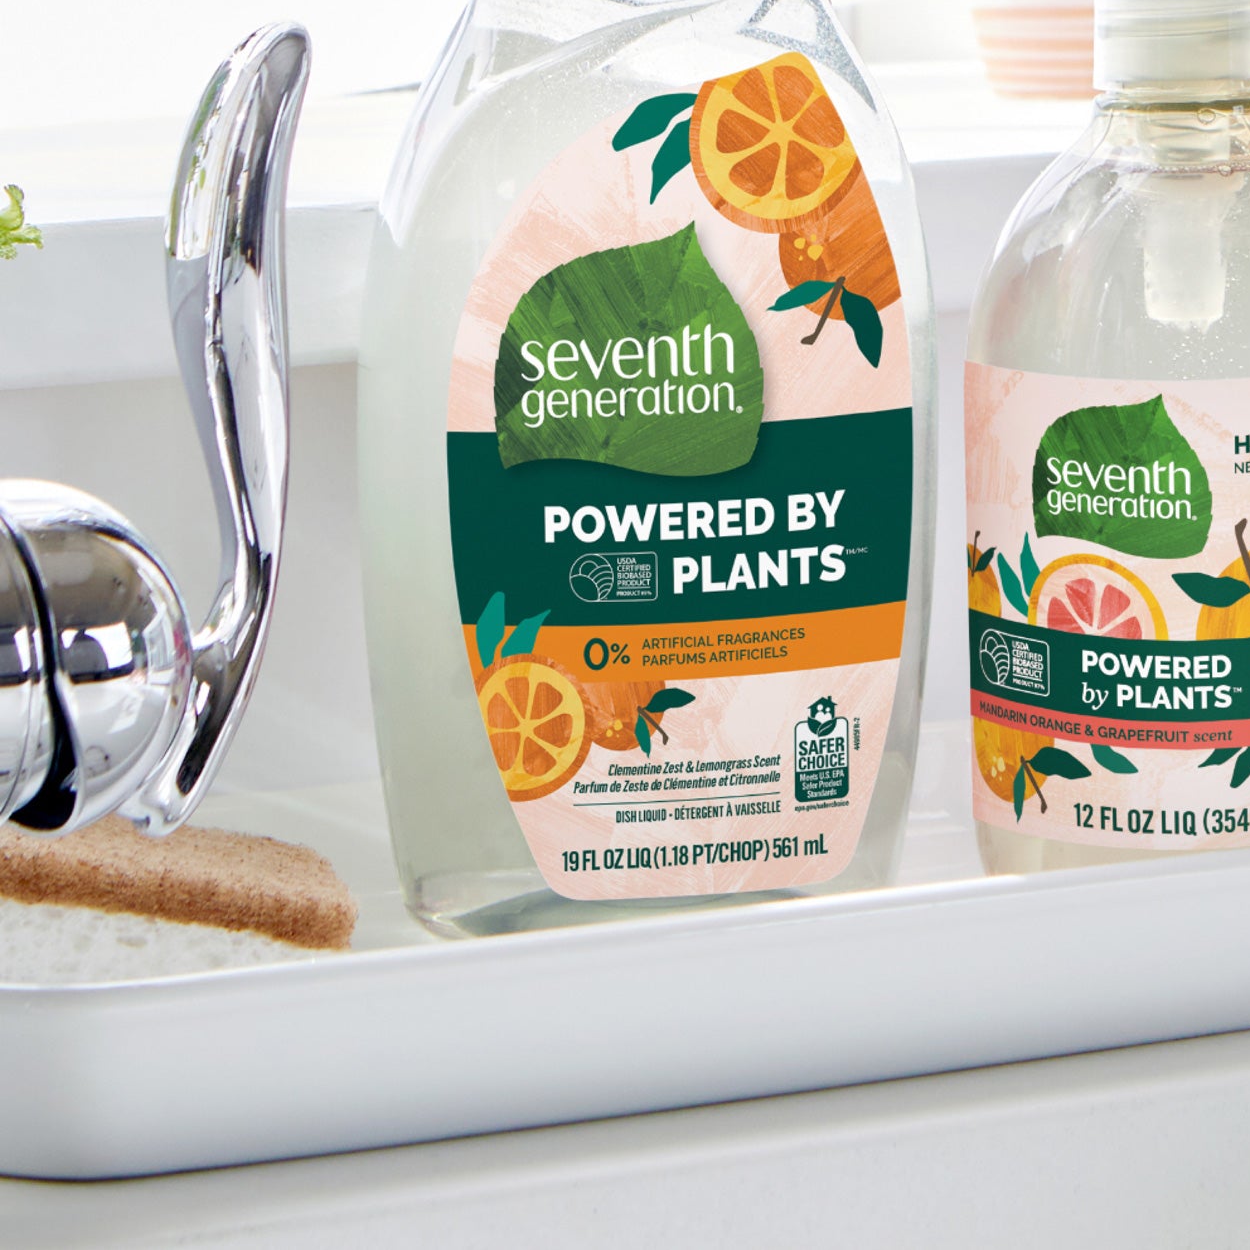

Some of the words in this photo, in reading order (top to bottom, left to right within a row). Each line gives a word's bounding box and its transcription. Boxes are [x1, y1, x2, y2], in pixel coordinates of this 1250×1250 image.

[520, 323, 735, 382] seventh
[1046, 456, 1192, 495] seventh
[543, 497, 775, 543] POWERED
[787, 489, 846, 532] BY
[616, 557, 637, 565] USDA
[616, 564, 652, 572] CERTIFIED
[673, 543, 846, 594] PLANTS
[616, 572, 652, 580] BIOBASED
[616, 578, 652, 587] PRODUCT
[641, 635, 714, 650] ARTIFICIAL
[717, 627, 806, 647] FRAGRANCES
[583, 637, 631, 671] 0%
[642, 652, 707, 667] PARFUMS
[709, 645, 788, 663] ARTIFICIELS
[1081, 649, 1233, 680] POWERED
[1012, 665, 1043, 678] PRODUCT
[1081, 681, 1110, 711] by
[979, 701, 1028, 724] MANDARIN
[1029, 713, 1082, 736] ORANGE
[1084, 725, 1094, 737] &
[1097, 725, 1190, 743] GRAPEFRUIT
[1193, 729, 1233, 743] scent
[798, 737, 845, 756] SAFER
[607, 763, 663, 777] Clementine
[662, 761, 685, 775] Zest
[685, 760, 695, 774] &
[695, 758, 753, 773] Lemongrass
[753, 754, 781, 768] Scent
[798, 753, 845, 770] CHOICE
[573, 781, 608, 794] Parfum
[609, 780, 622, 793] de
[622, 779, 650, 793] Zeste
[650, 778, 663, 791] de
[663, 775, 718, 791] Clémentine
[718, 774, 729, 787] et
[729, 770, 781, 786] Citronnelle
[799, 773, 819, 782] Meets
[819, 771, 831, 780] U.S.
[832, 768, 845, 778] EPA
[802, 780, 818, 790] Safer
[819, 778, 842, 788] Product
[807, 788, 837, 798] Standards
[615, 810, 637, 824] DISH
[638, 807, 667, 823] LIQUID
[674, 805, 725, 821] DÉTERGENT
[726, 801, 733, 817] À
[734, 800, 781, 816] VAISSELLE
[1073, 802, 1094, 828] 12
[1100, 806, 1123, 832] FL
[1127, 809, 1154, 834] OZ
[1161, 810, 1197, 836] LIQ
[1203, 807, 1250, 835] (354
[562, 851, 579, 871] 19
[582, 850, 600, 870] FL
[603, 848, 624, 869] OZ
[627, 847, 652, 869] LIQ
[653, 845, 689, 869] (1.18
[692, 838, 770, 865] PT/CHOP)
[772, 836, 799, 858] 561
[803, 833, 828, 855] mL
